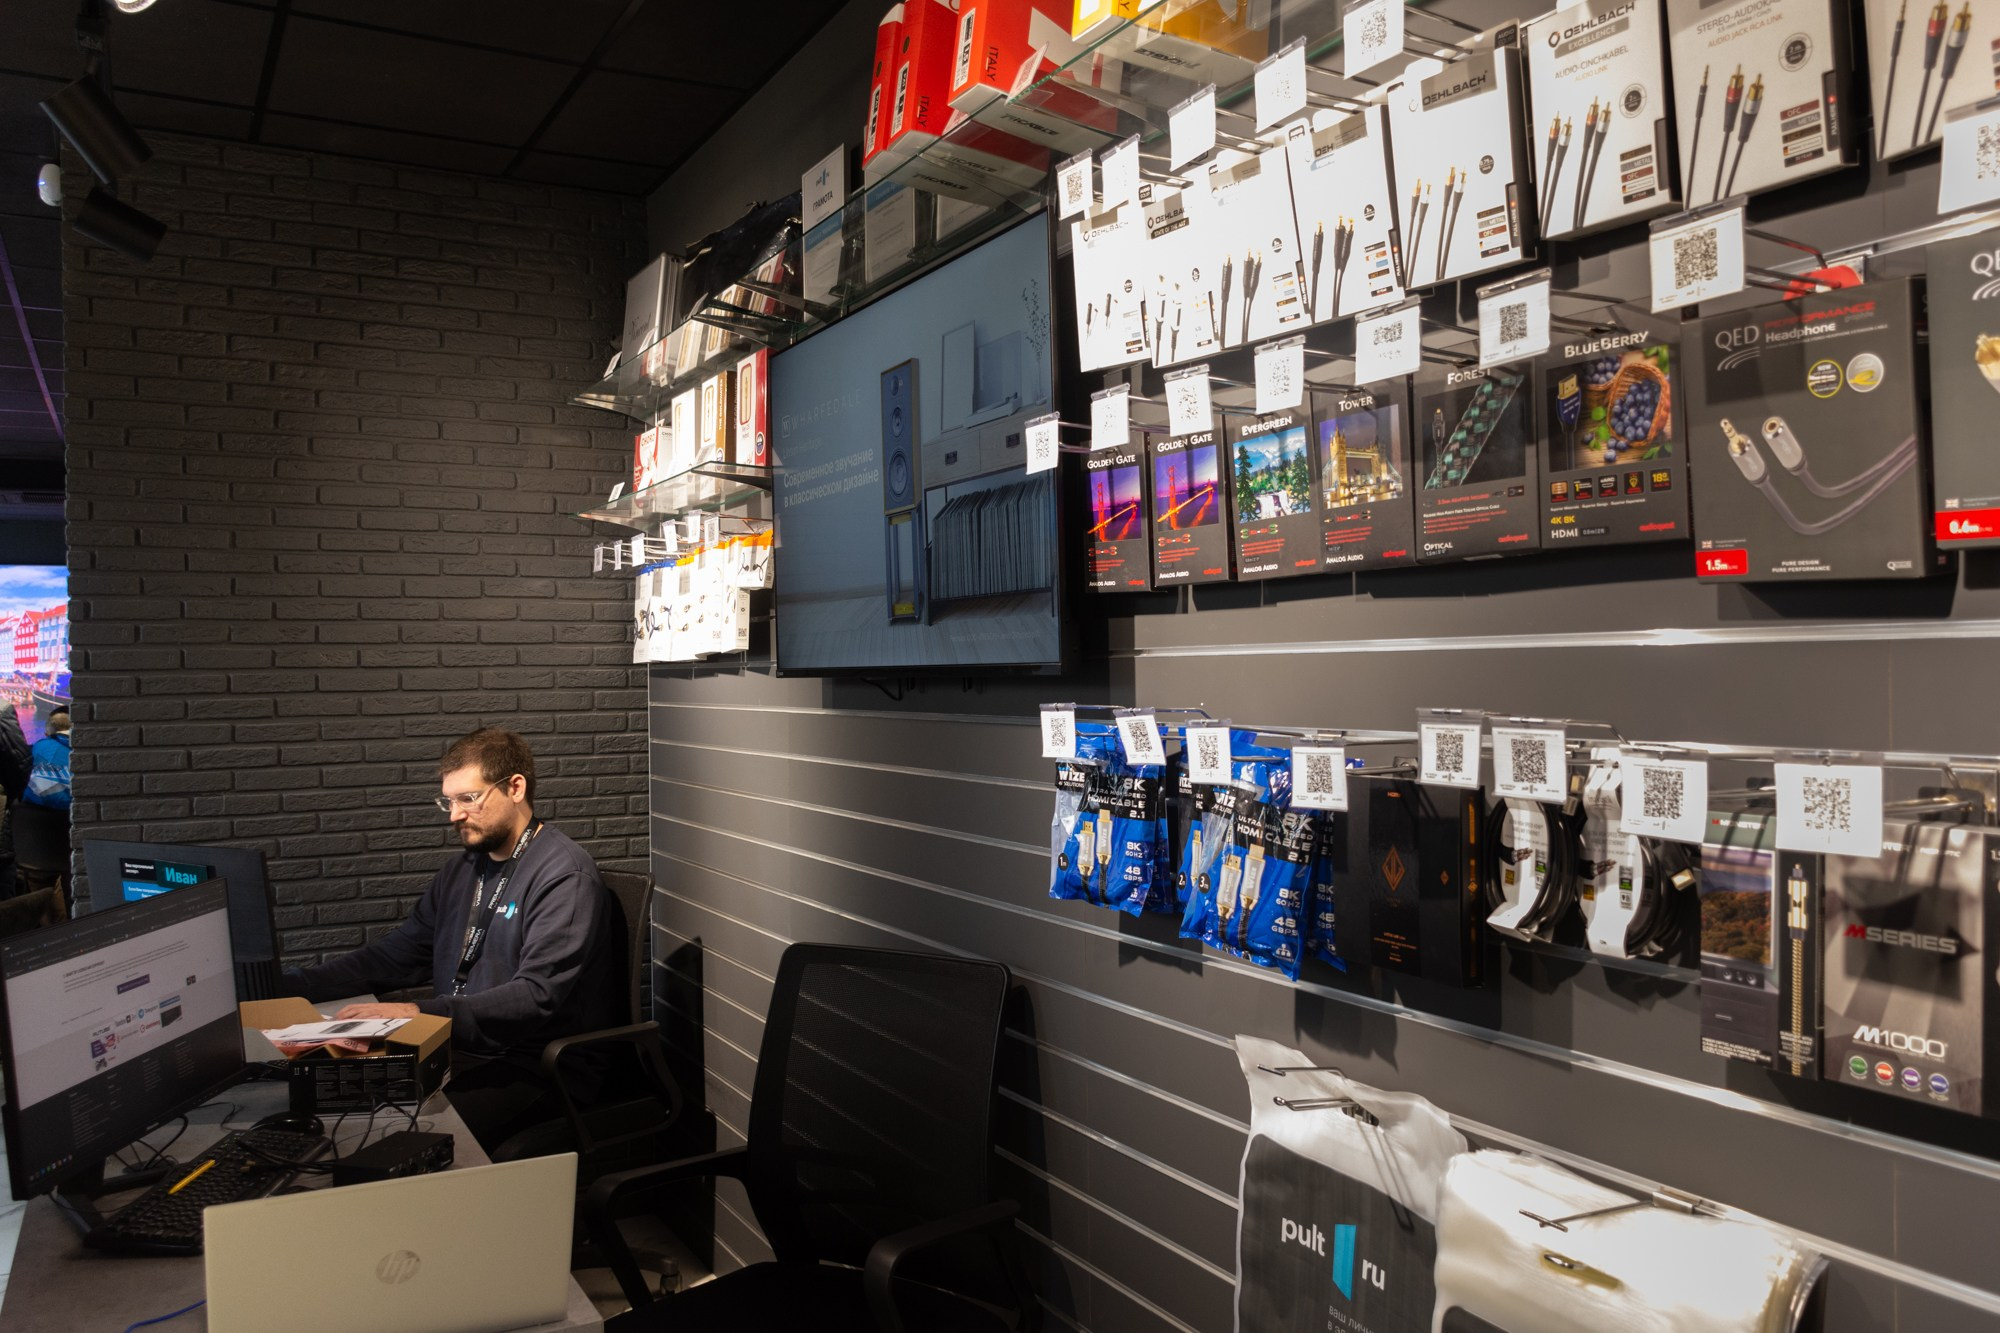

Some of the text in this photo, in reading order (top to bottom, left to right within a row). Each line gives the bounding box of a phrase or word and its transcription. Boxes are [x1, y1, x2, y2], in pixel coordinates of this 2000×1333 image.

[1563, 1, 1636, 40] OEHLBACH
[1696, 0, 1780, 35] STEREO-AUDIOKA
[1568, 25, 1617, 51] EXCELLENCE
[1707, 13, 1783, 48] AUDIO JACK RCA LINK
[987, 46, 999, 81] ITALY
[1554, 44, 1629, 79] AUDIO-CINCHKABEL
[1422, 74, 1486, 107] OEHLBACH
[917, 95, 930, 127] ITALY
[1715, 325, 1760, 351] QED
[1765, 322, 1836, 344] Headphone
[1338, 396, 1373, 412] TOWER
[1241, 416, 1293, 436] EVERGREEN
[1157, 433, 1213, 453] GOLDEN GATE
[783, 448, 874, 489] Современное звучание
[1087, 454, 1136, 470] GOLDEN GATE
[789, 481, 842, 506] классическом
[843, 467, 879, 494] дизайне
[1550, 516, 1562, 525] 4K
[1551, 528, 1579, 539] HDMI
[1423, 541, 1454, 552] OPTICAL
[1326, 553, 1364, 564] ANALOG AUDIO
[1705, 558, 1729, 571] 1.5m
[1797, 559, 1820, 567] DESIGN
[1159, 570, 1189, 580] ANALOG AUDIO
[1242, 563, 1278, 574] ANALOG AUDIO
[1788, 565, 1831, 573] PERFORMANCE
[1104, 579, 1116, 587] AUDIO
[1123, 777, 1147, 792] 8K
[1087, 794, 1147, 809] HDMI CABLE
[1129, 810, 1146, 819] 2.1
[1238, 815, 1263, 828] ULTRA
[1284, 812, 1314, 832] 8K
[1237, 824, 1311, 852] HDMI CABLE
[1126, 841, 1142, 852] 8K
[1288, 851, 1309, 864] 2.1
[165, 867, 198, 885] Иван
[1123, 874, 1143, 882] GBPS
[1125, 865, 1141, 875] 48
[1278, 887, 1300, 900] 8K
[1275, 897, 1301, 908] 60HZ
[1274, 916, 1296, 928] 48
[1271, 925, 1299, 937] GBPS
[1843, 923, 1957, 954] MSERIES
[1853, 1025, 1946, 1058] M1000
[1281, 1217, 1326, 1257] pult
[1361, 1258, 1386, 1291] ru
[1329, 1304, 1347, 1323] ваш
[1327, 1320, 1333, 1331] в
